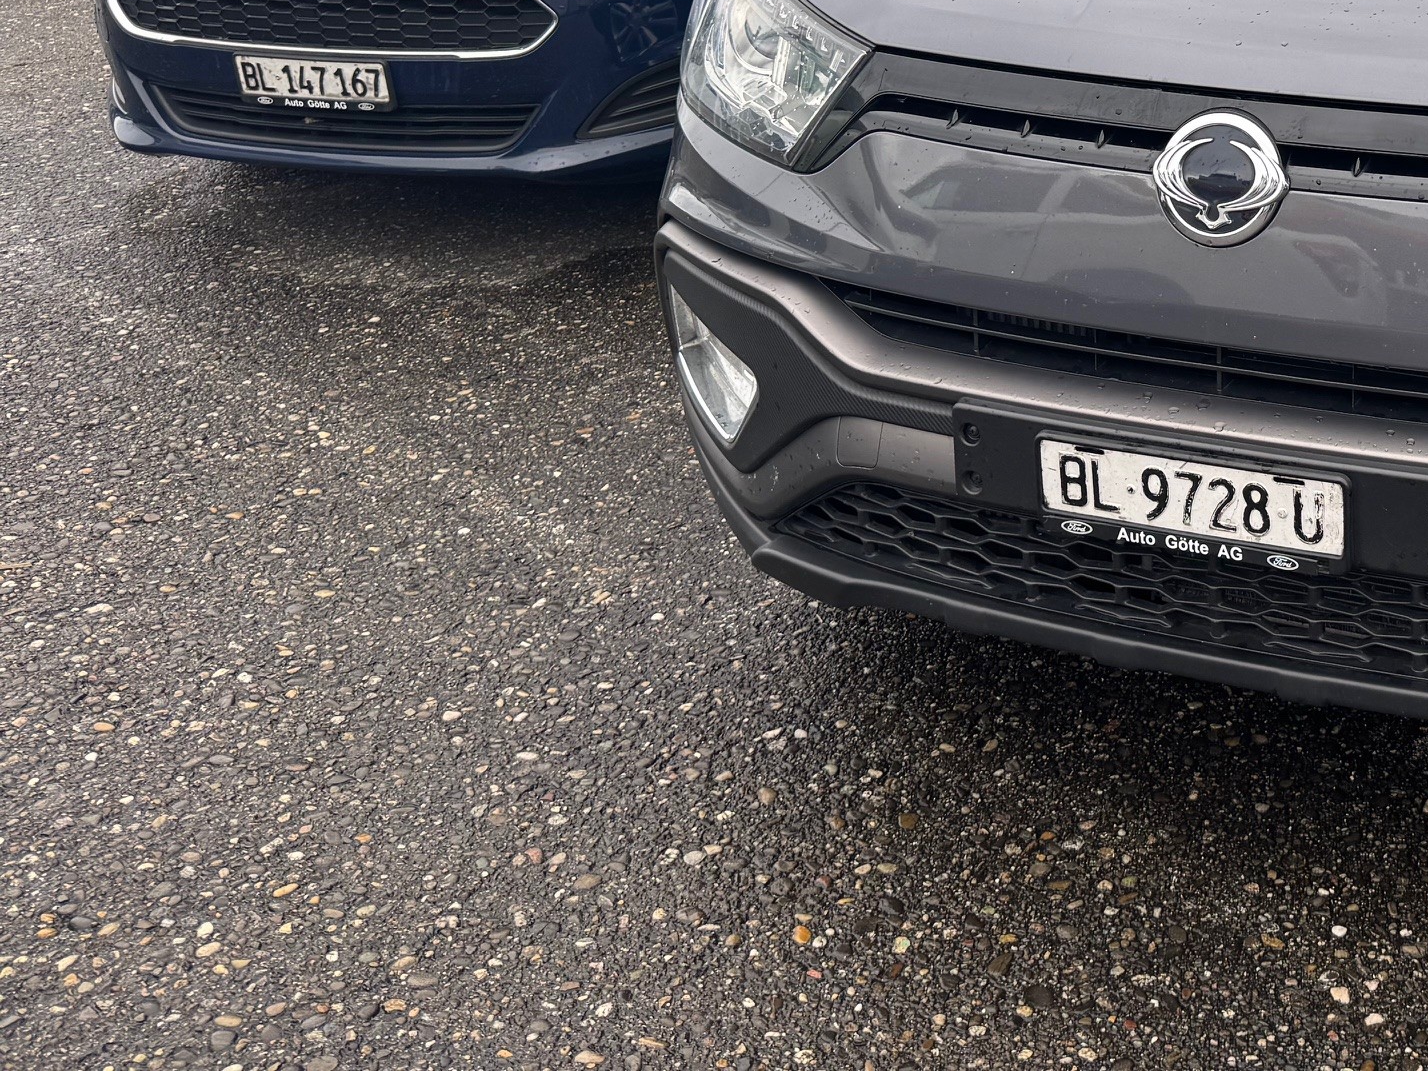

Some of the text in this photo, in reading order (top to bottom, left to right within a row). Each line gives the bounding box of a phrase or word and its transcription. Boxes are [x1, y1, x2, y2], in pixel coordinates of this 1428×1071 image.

[241, 61, 277, 92] BL
[333, 101, 348, 110] AG
[1059, 452, 1122, 514] BL
[1140, 466, 1272, 538] 9728
[1116, 527, 1243, 561] Auto Götte AG
